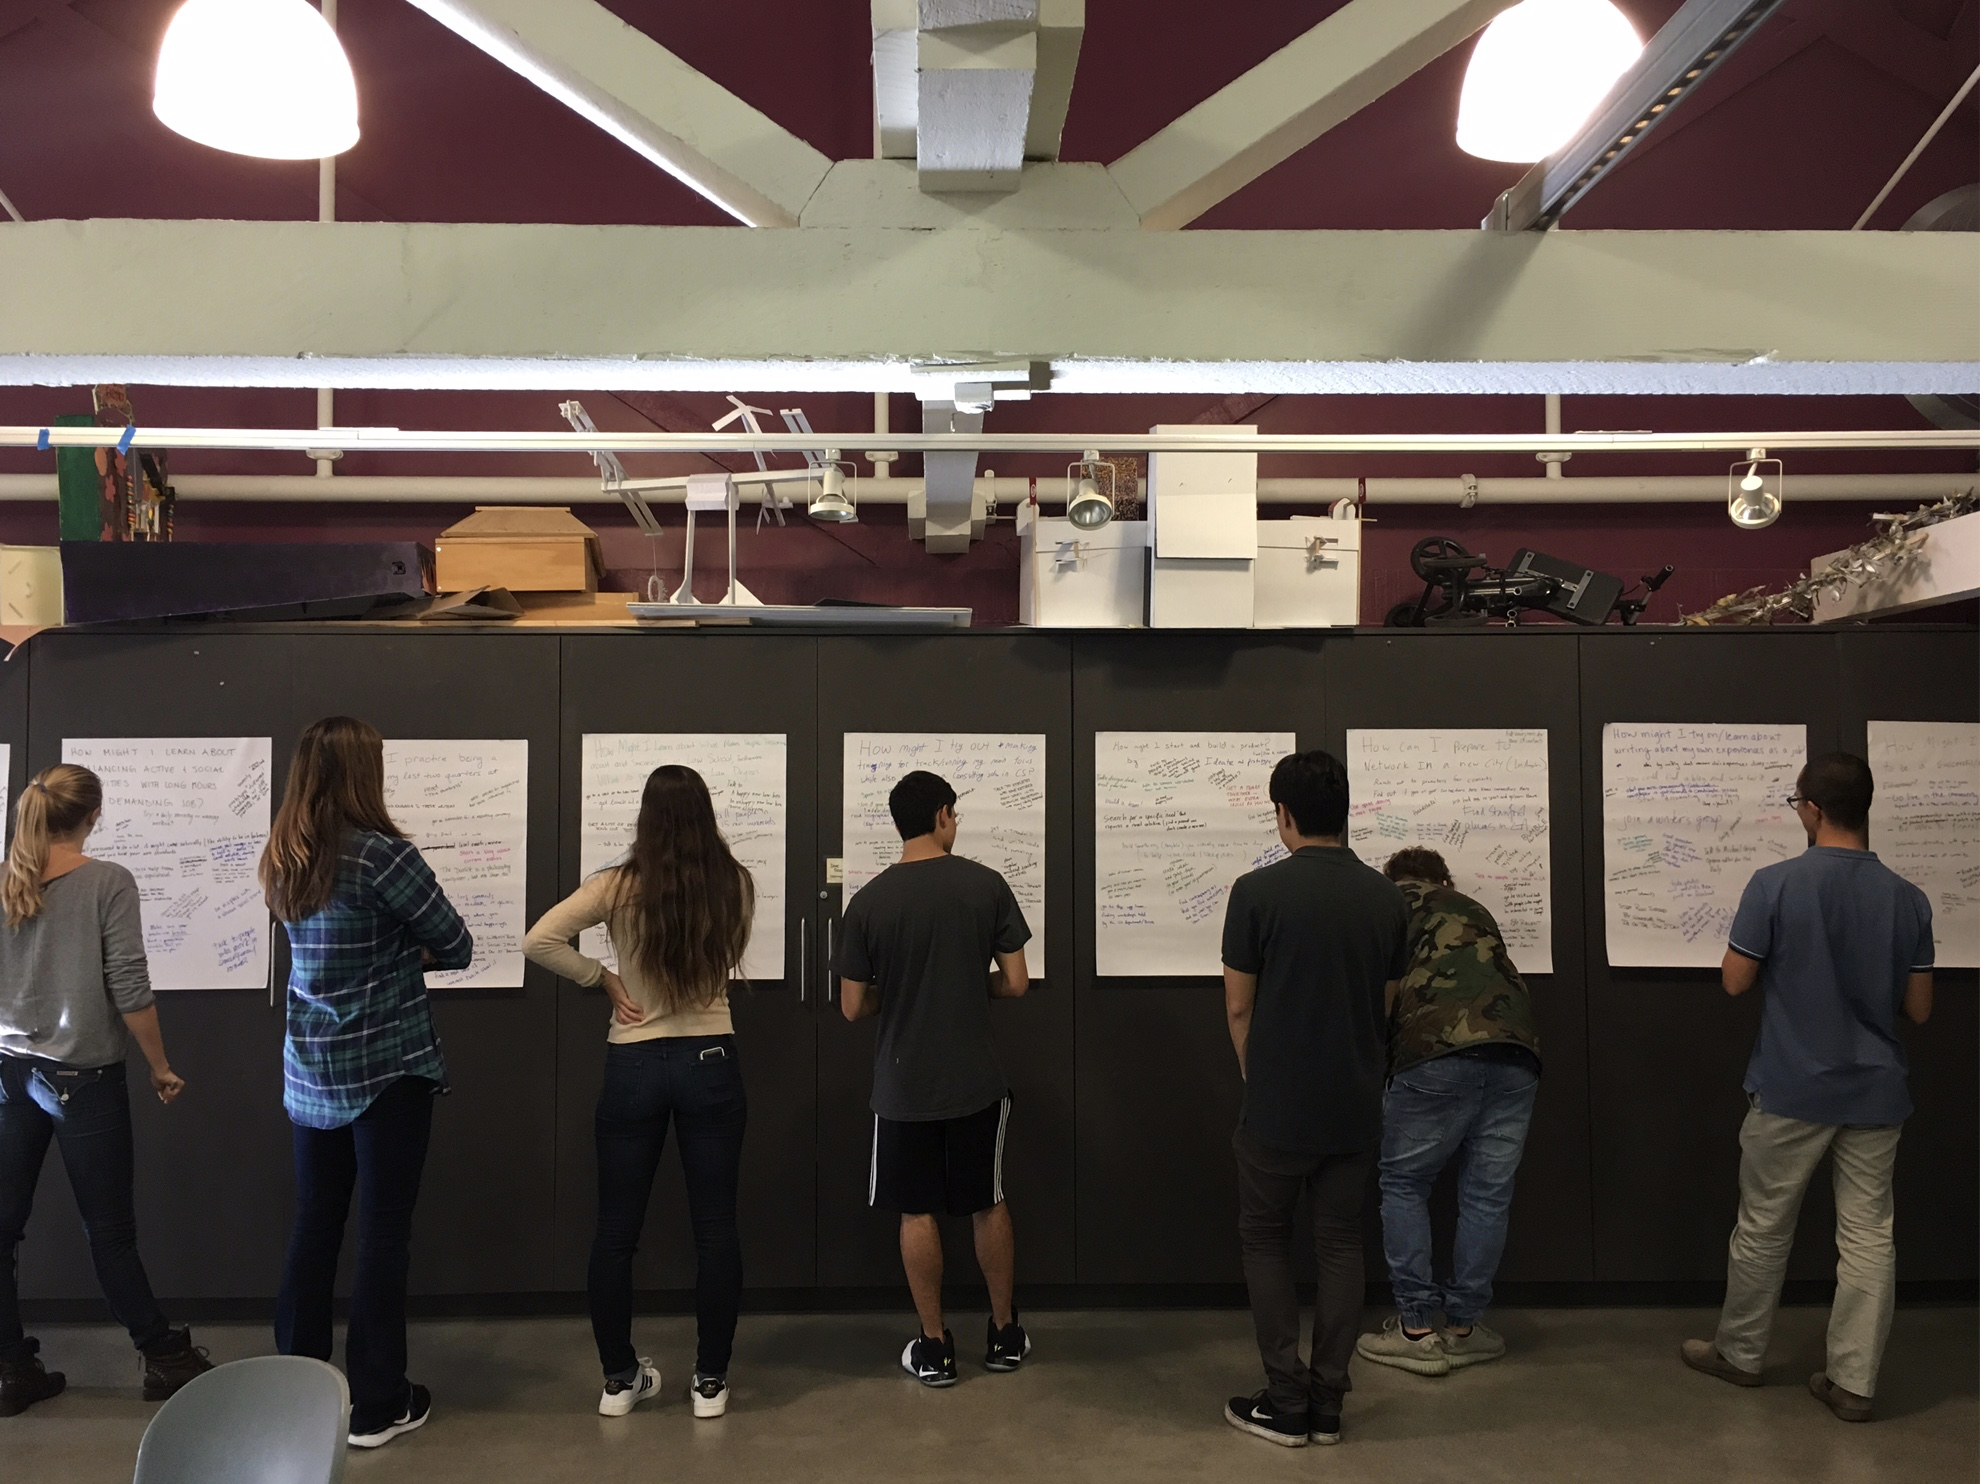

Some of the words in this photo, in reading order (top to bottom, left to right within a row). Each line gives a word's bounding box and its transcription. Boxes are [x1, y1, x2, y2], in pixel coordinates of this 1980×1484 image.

[1613, 728, 1638, 739] How
[1641, 730, 1672, 744] might
[1678, 729, 1688, 740] I
[1689, 730, 1704, 744] try
[1751, 729, 1782, 741] about
[618, 739, 641, 758] Might
[654, 740, 673, 751] Learn
[860, 739, 892, 758] How
[900, 742, 928, 758] might
[934, 738, 944, 752] I
[950, 738, 963, 754] try
[1112, 740, 1129, 751] How
[1154, 742, 1160, 750] I
[1165, 742, 1184, 750] start
[1207, 741, 1227, 750] build
[1240, 738, 1272, 752] product?
[1362, 736, 1390, 753] How
[1429, 736, 1442, 753] I
[1885, 735, 1915, 754] How
[1970, 736, 1976, 746] I
[71, 748, 92, 756] HOW
[103, 748, 138, 756] MIGHT
[165, 748, 196, 756] LEARN
[202, 748, 236, 756] ABOUT
[1614, 744, 1651, 760] writing
[1654, 744, 1679, 754] about
[1682, 747, 1697, 760] my
[1768, 746, 1779, 754] as
[386, 752, 398, 764] I
[404, 753, 448, 766] practice
[459, 752, 482, 770] being
[898, 760, 910, 768] for
[972, 759, 986, 770] my
[1014, 756, 1034, 765] focus
[1126, 756, 1140, 769] by
[1364, 759, 1410, 772] Network
[1460, 760, 1480, 768] new
[144, 765, 175, 774] ACTIVE
[192, 766, 224, 774] SOCIAL
[386, 774, 399, 786] my
[402, 770, 420, 781] last
[445, 770, 482, 784] quarters
[488, 768, 499, 776] at
[860, 774, 878, 784] while
[882, 774, 897, 782] also
[1373, 778, 1392, 786] Reach
[141, 780, 160, 789] WITH
[164, 781, 187, 790] LONG
[1386, 790, 1398, 798] out
[108, 798, 174, 807] DEMANDING
[1104, 813, 1128, 823] Search
[1144, 812, 1163, 821] specific
[1462, 804, 1486, 817] Find
[1488, 803, 1526, 823] Stanford
[1618, 815, 1642, 831] join
[1696, 815, 1724, 832] group
